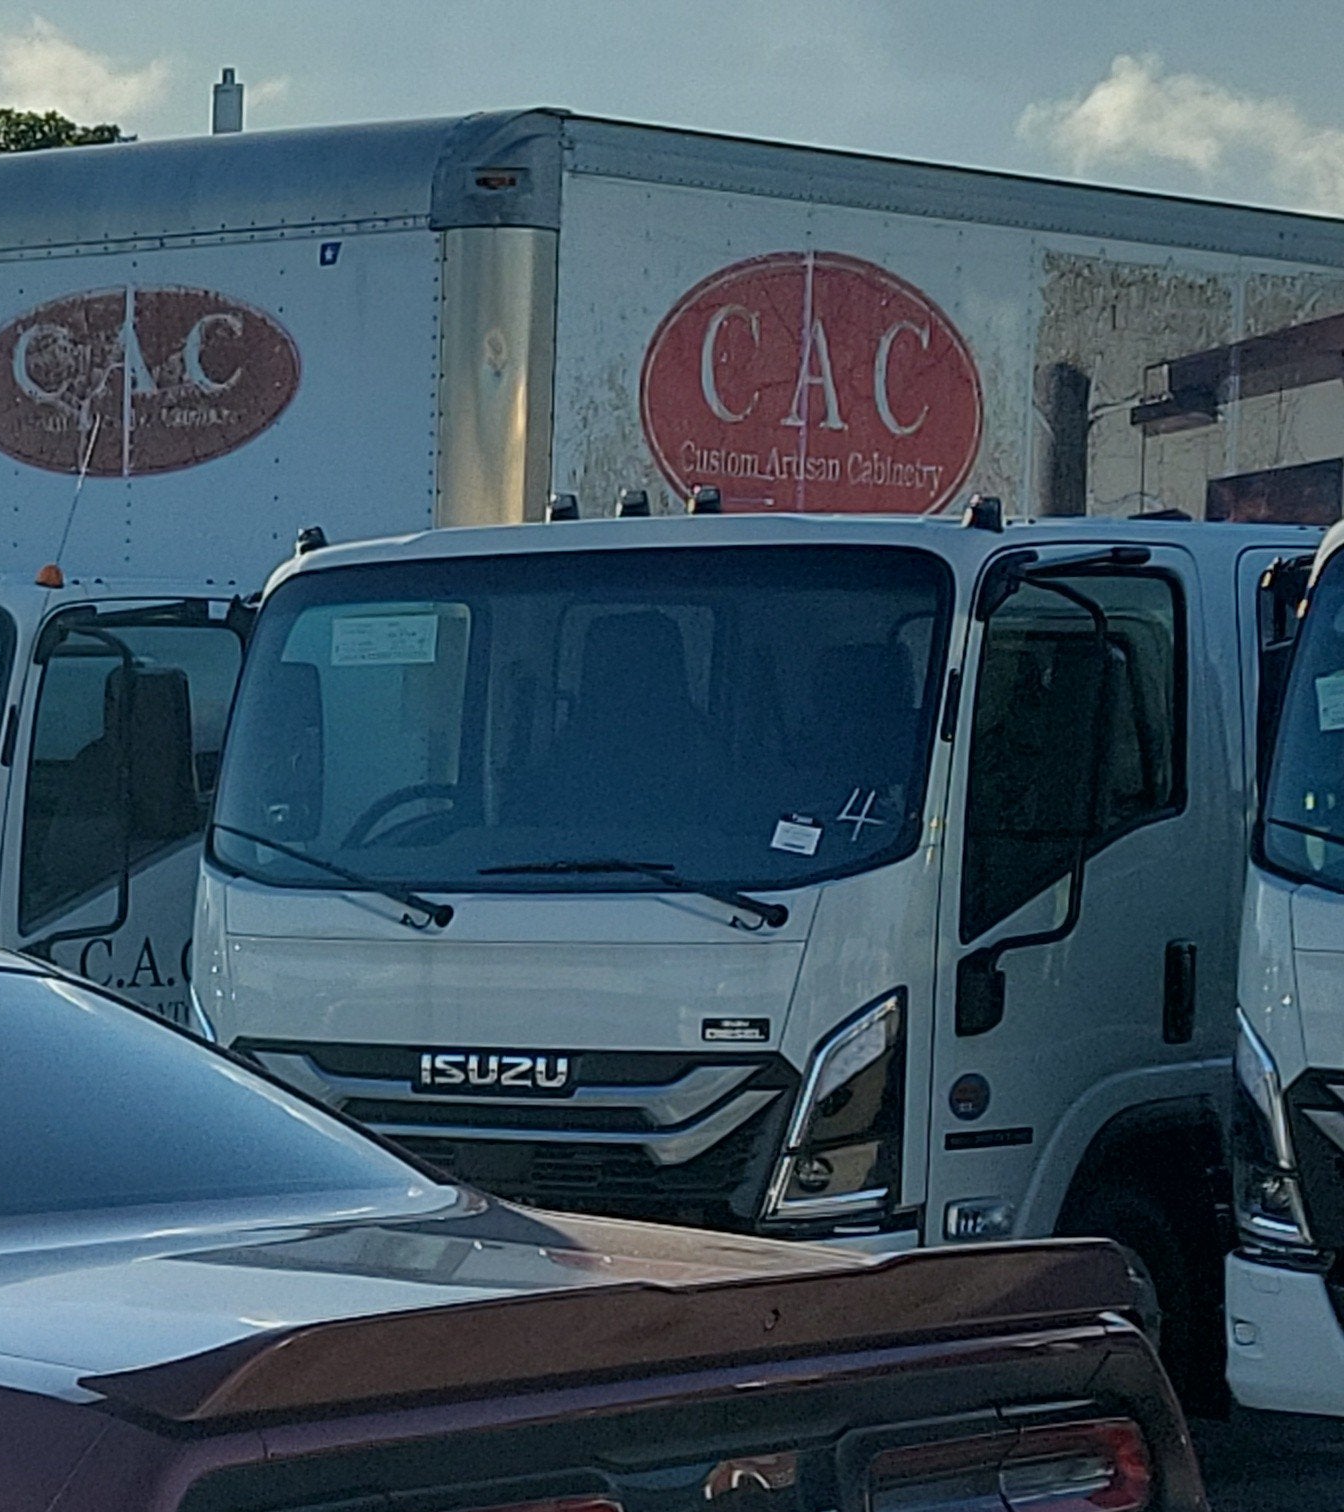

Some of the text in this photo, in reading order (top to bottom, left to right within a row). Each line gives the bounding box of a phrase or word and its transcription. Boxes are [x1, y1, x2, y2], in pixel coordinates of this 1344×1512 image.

[680, 440, 758, 478] Custom
[836, 787, 888, 841] 4
[421, 1053, 568, 1088] ISUZU
